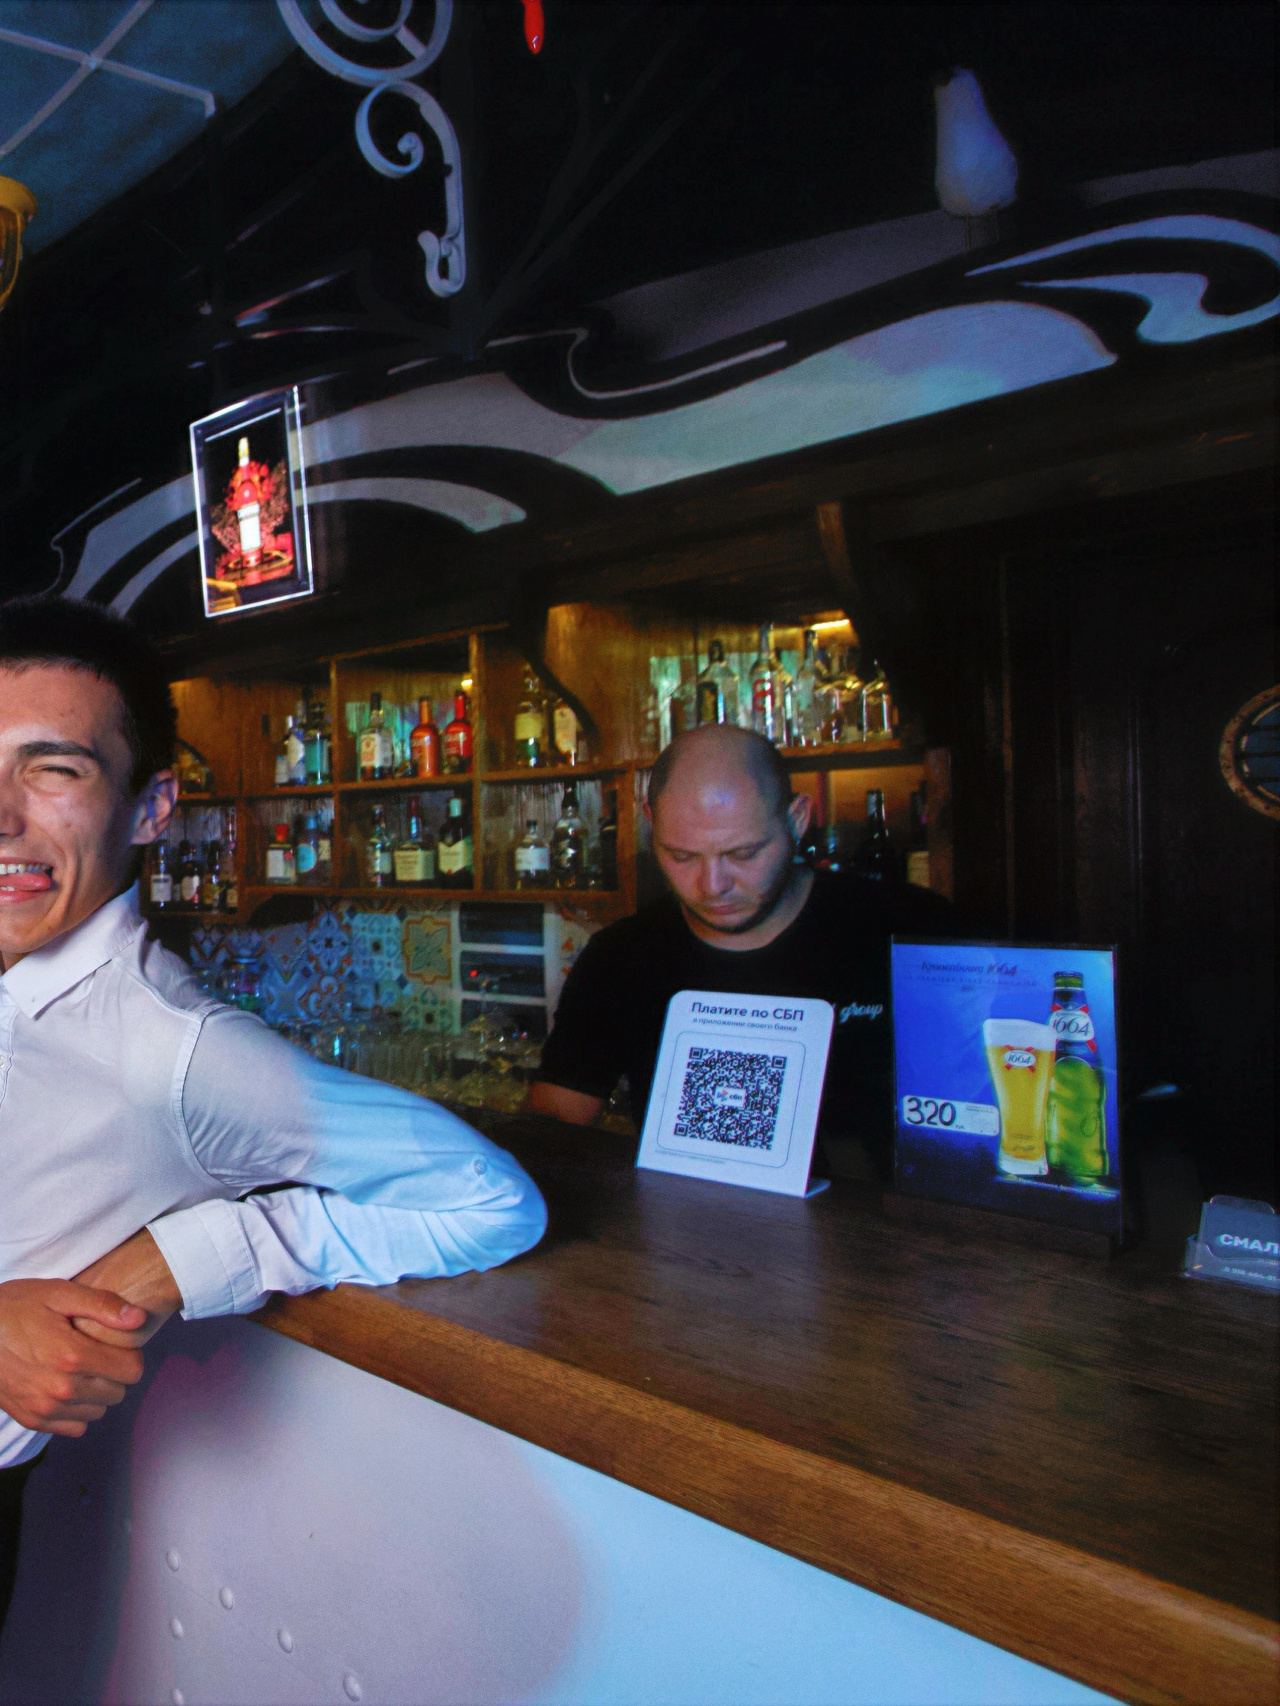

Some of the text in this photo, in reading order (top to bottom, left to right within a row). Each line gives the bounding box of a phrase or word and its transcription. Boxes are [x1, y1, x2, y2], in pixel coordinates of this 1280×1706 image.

[987, 962, 1018, 977] 1664
[691, 1002, 804, 1021] Платите по СБП
[699, 1018, 746, 1027] приложении
[747, 1022, 773, 1030] своего
[774, 1022, 798, 1032] банка
[1052, 1016, 1091, 1037] 1664
[1008, 1054, 1031, 1065] 1664
[907, 1097, 957, 1127] 320
